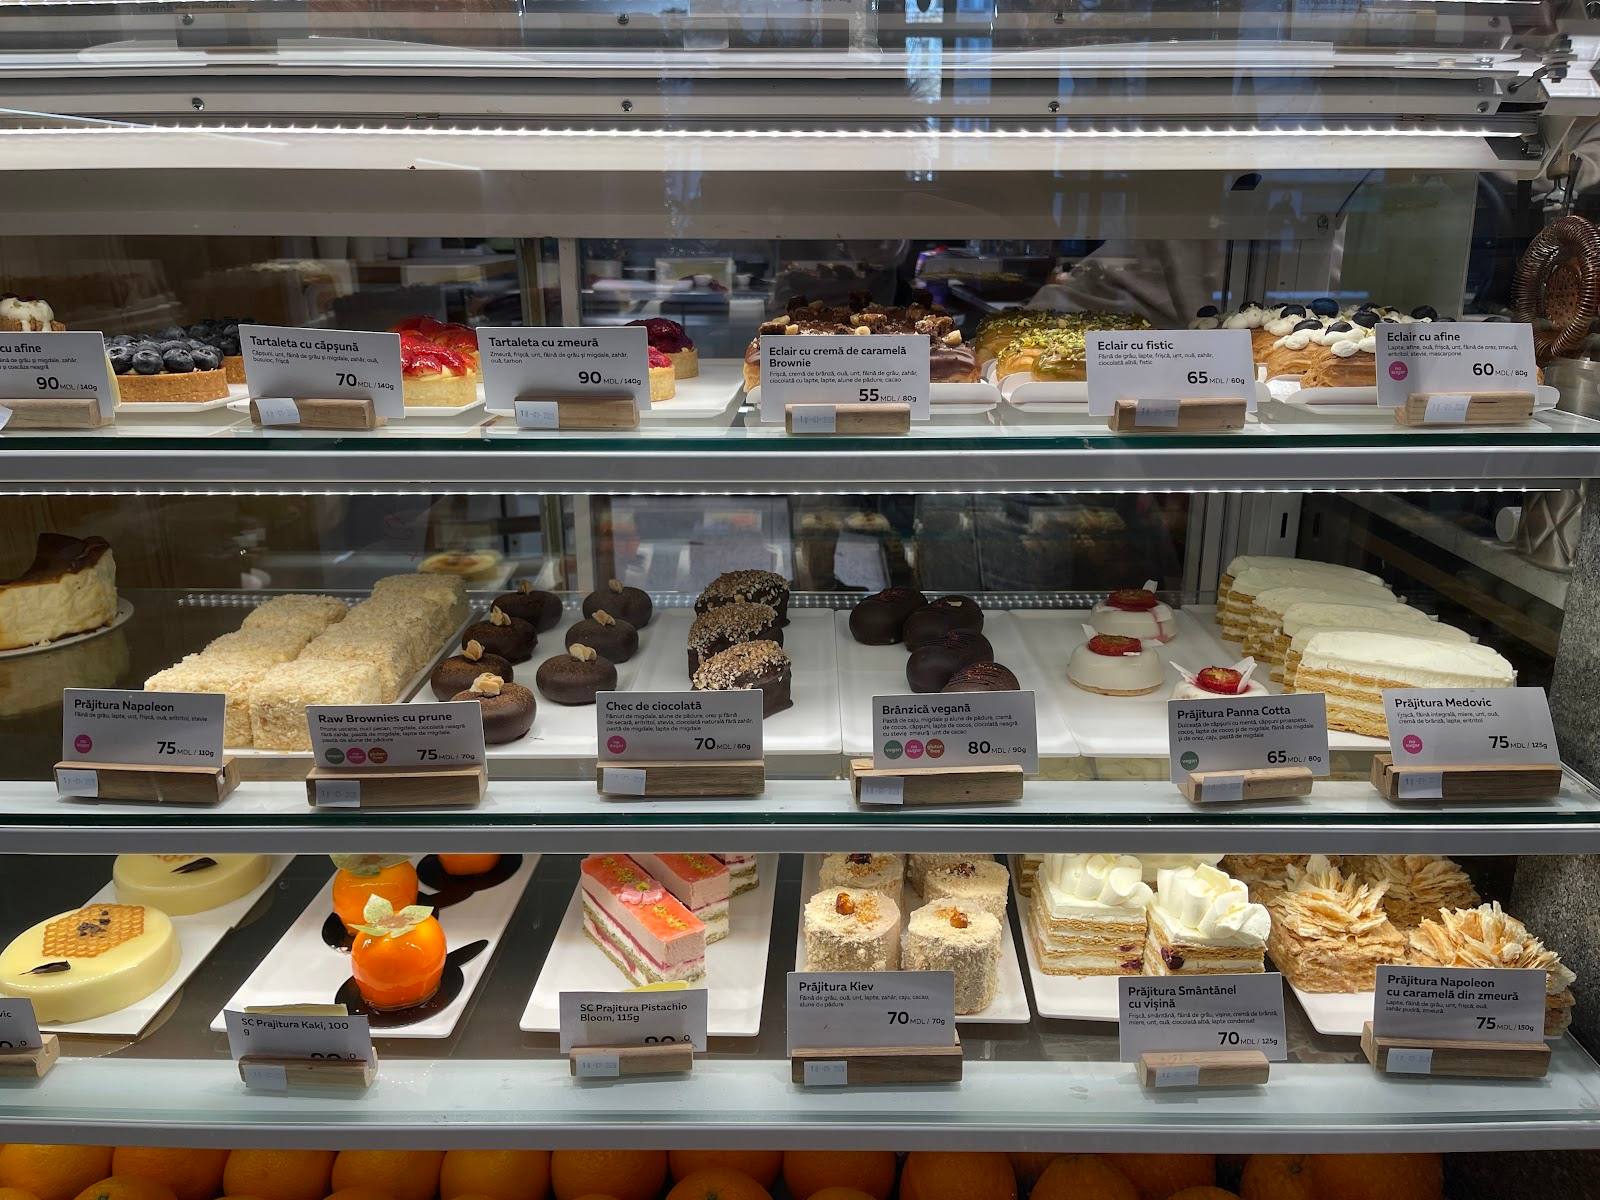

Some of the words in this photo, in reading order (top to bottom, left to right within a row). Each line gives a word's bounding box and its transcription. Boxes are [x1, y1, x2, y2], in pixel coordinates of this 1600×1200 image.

[489, 337, 540, 347] Tartaleta
[541, 338, 555, 347] cu
[557, 337, 599, 347] zmeură
[1387, 332, 1417, 342] Eclair
[1433, 332, 1461, 341] afine
[0, 345, 12, 353] cu
[14, 343, 42, 353] afine
[250, 335, 298, 348] Tartaleta
[300, 340, 312, 349] cu
[314, 340, 359, 353] căpșună
[769, 346, 798, 356] Eclair
[799, 348, 811, 356] cu
[813, 346, 844, 356] cremă
[846, 346, 859, 355] de
[860, 345, 907, 355] caramelă
[1097, 340, 1129, 351] Eclair
[1130, 342, 1143, 350] cu
[1146, 340, 1174, 350] fistic
[769, 358, 811, 368] Brownie
[1472, 363, 1494, 376] 60
[36, 376, 60, 390] 90
[335, 373, 357, 387] 70
[357, 381, 373, 389] MDL
[377, 383, 395, 391] 140g
[578, 371, 602, 384] 90
[624, 378, 642, 386] 140g
[1187, 371, 1208, 384] 65
[1231, 377, 1245, 385] 60g
[859, 388, 879, 402] 55
[74, 698, 120, 711] Prăjitura
[122, 701, 174, 713] Napoleon
[605, 701, 633, 711] Chec
[635, 701, 649, 711] de
[651, 701, 702, 711] ciocolată
[882, 704, 930, 715] Brânzică
[931, 703, 971, 716] vegană
[1395, 698, 1443, 709] Prăjitura
[1445, 697, 1492, 707] Medovic
[318, 714, 344, 723] Raw
[346, 714, 400, 723] Brownies
[418, 713, 452, 723] prune
[1177, 709, 1224, 721] Prăjitura
[1226, 708, 1260, 717] Panna
[1261, 706, 1291, 716] Cotta
[694, 737, 716, 750] 70
[737, 743, 751, 751] 60g
[968, 741, 991, 754] 80
[1012, 746, 1027, 754] 90g
[1488, 735, 1509, 749] 75
[1531, 742, 1548, 750] 125g
[157, 741, 176, 755] 75
[198, 749, 214, 758] 110g
[417, 749, 438, 761] 75
[1267, 750, 1287, 764] 65
[1308, 755, 1322, 763] 80g
[799, 981, 847, 994] Prăjitura
[850, 981, 874, 992] Kiev
[1387, 974, 1438, 987] Prăjitura
[1440, 976, 1495, 989] Napoleon
[1128, 986, 1176, 999] Prăjitura
[1386, 988, 1400, 997] cu
[1402, 989, 1455, 999] caramelă
[1457, 990, 1475, 1000] din
[1477, 991, 1519, 1001] zmeură
[580, 1003, 594, 1012] SC
[596, 1003, 639, 1014] Prajitura
[641, 1002, 688, 1012] Pistachio
[1128, 1001, 1141, 1009] cu
[1143, 998, 1176, 1011] vișină
[580, 1013, 615, 1022] Bloom,
[617, 1013, 640, 1023] 115g
[887, 1011, 909, 1025] 70
[1476, 1016, 1496, 1030] 75
[1518, 1024, 1534, 1032] 150g
[241, 1018, 255, 1027] SC
[256, 1020, 299, 1032] Prajitura
[301, 1021, 326, 1031] Kaki,
[328, 1022, 349, 1030] 100
[1218, 1031, 1240, 1045] 70
[1262, 1038, 1278, 1046] 125g
